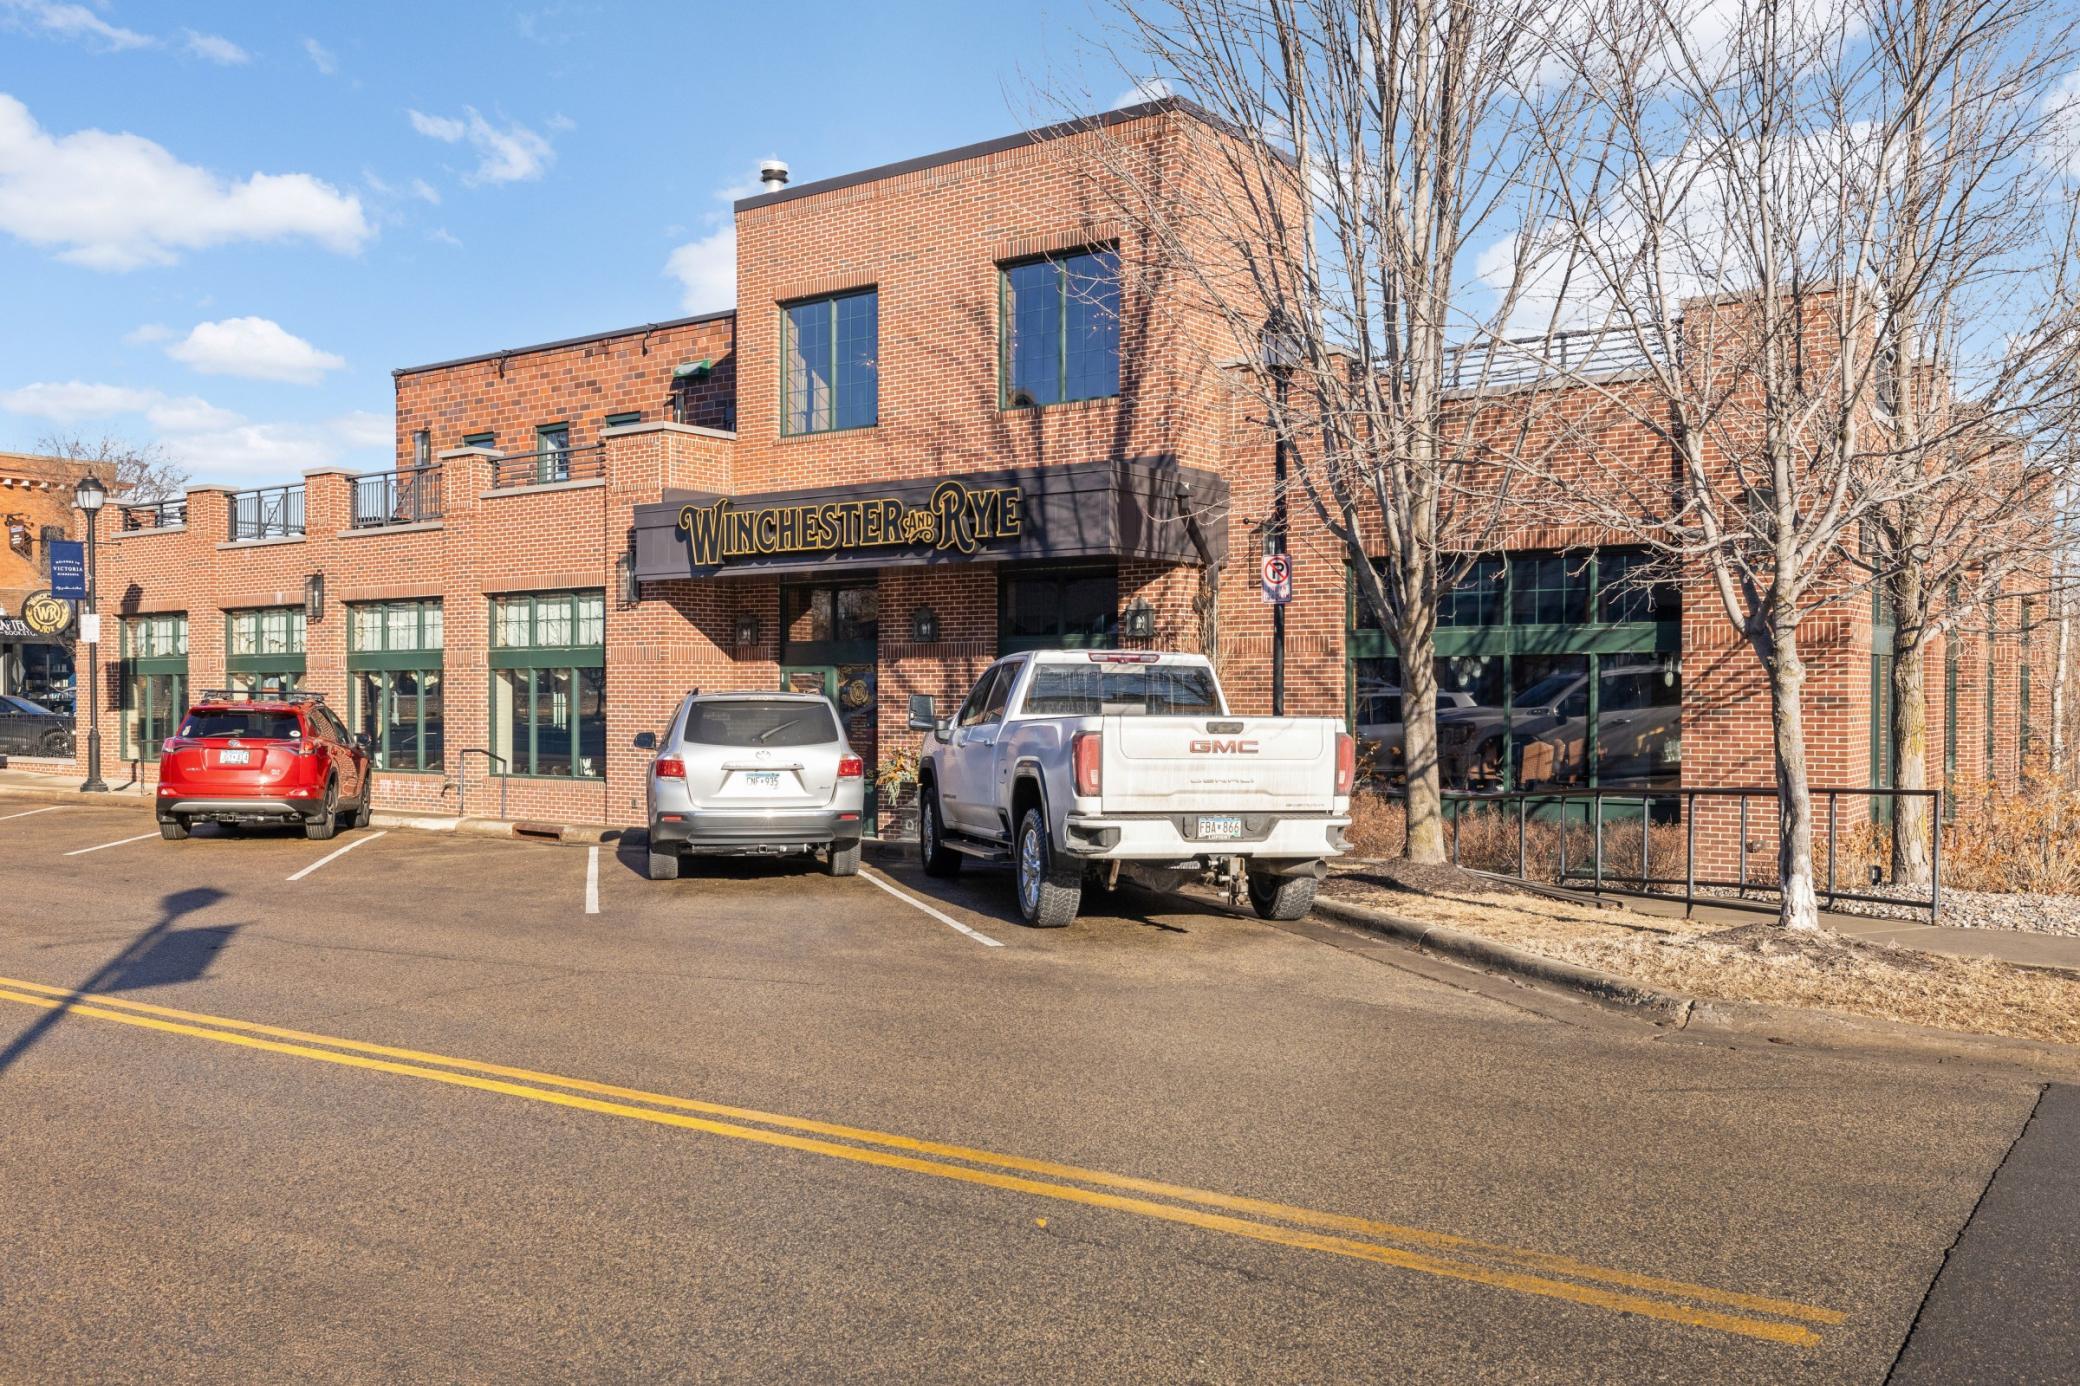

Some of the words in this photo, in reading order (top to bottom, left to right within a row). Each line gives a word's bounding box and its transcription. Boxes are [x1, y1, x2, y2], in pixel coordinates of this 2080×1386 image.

[678, 498, 905, 566] WINCHESTER
[930, 480, 1021, 554] RYE
[1189, 740, 1259, 754] GMC
